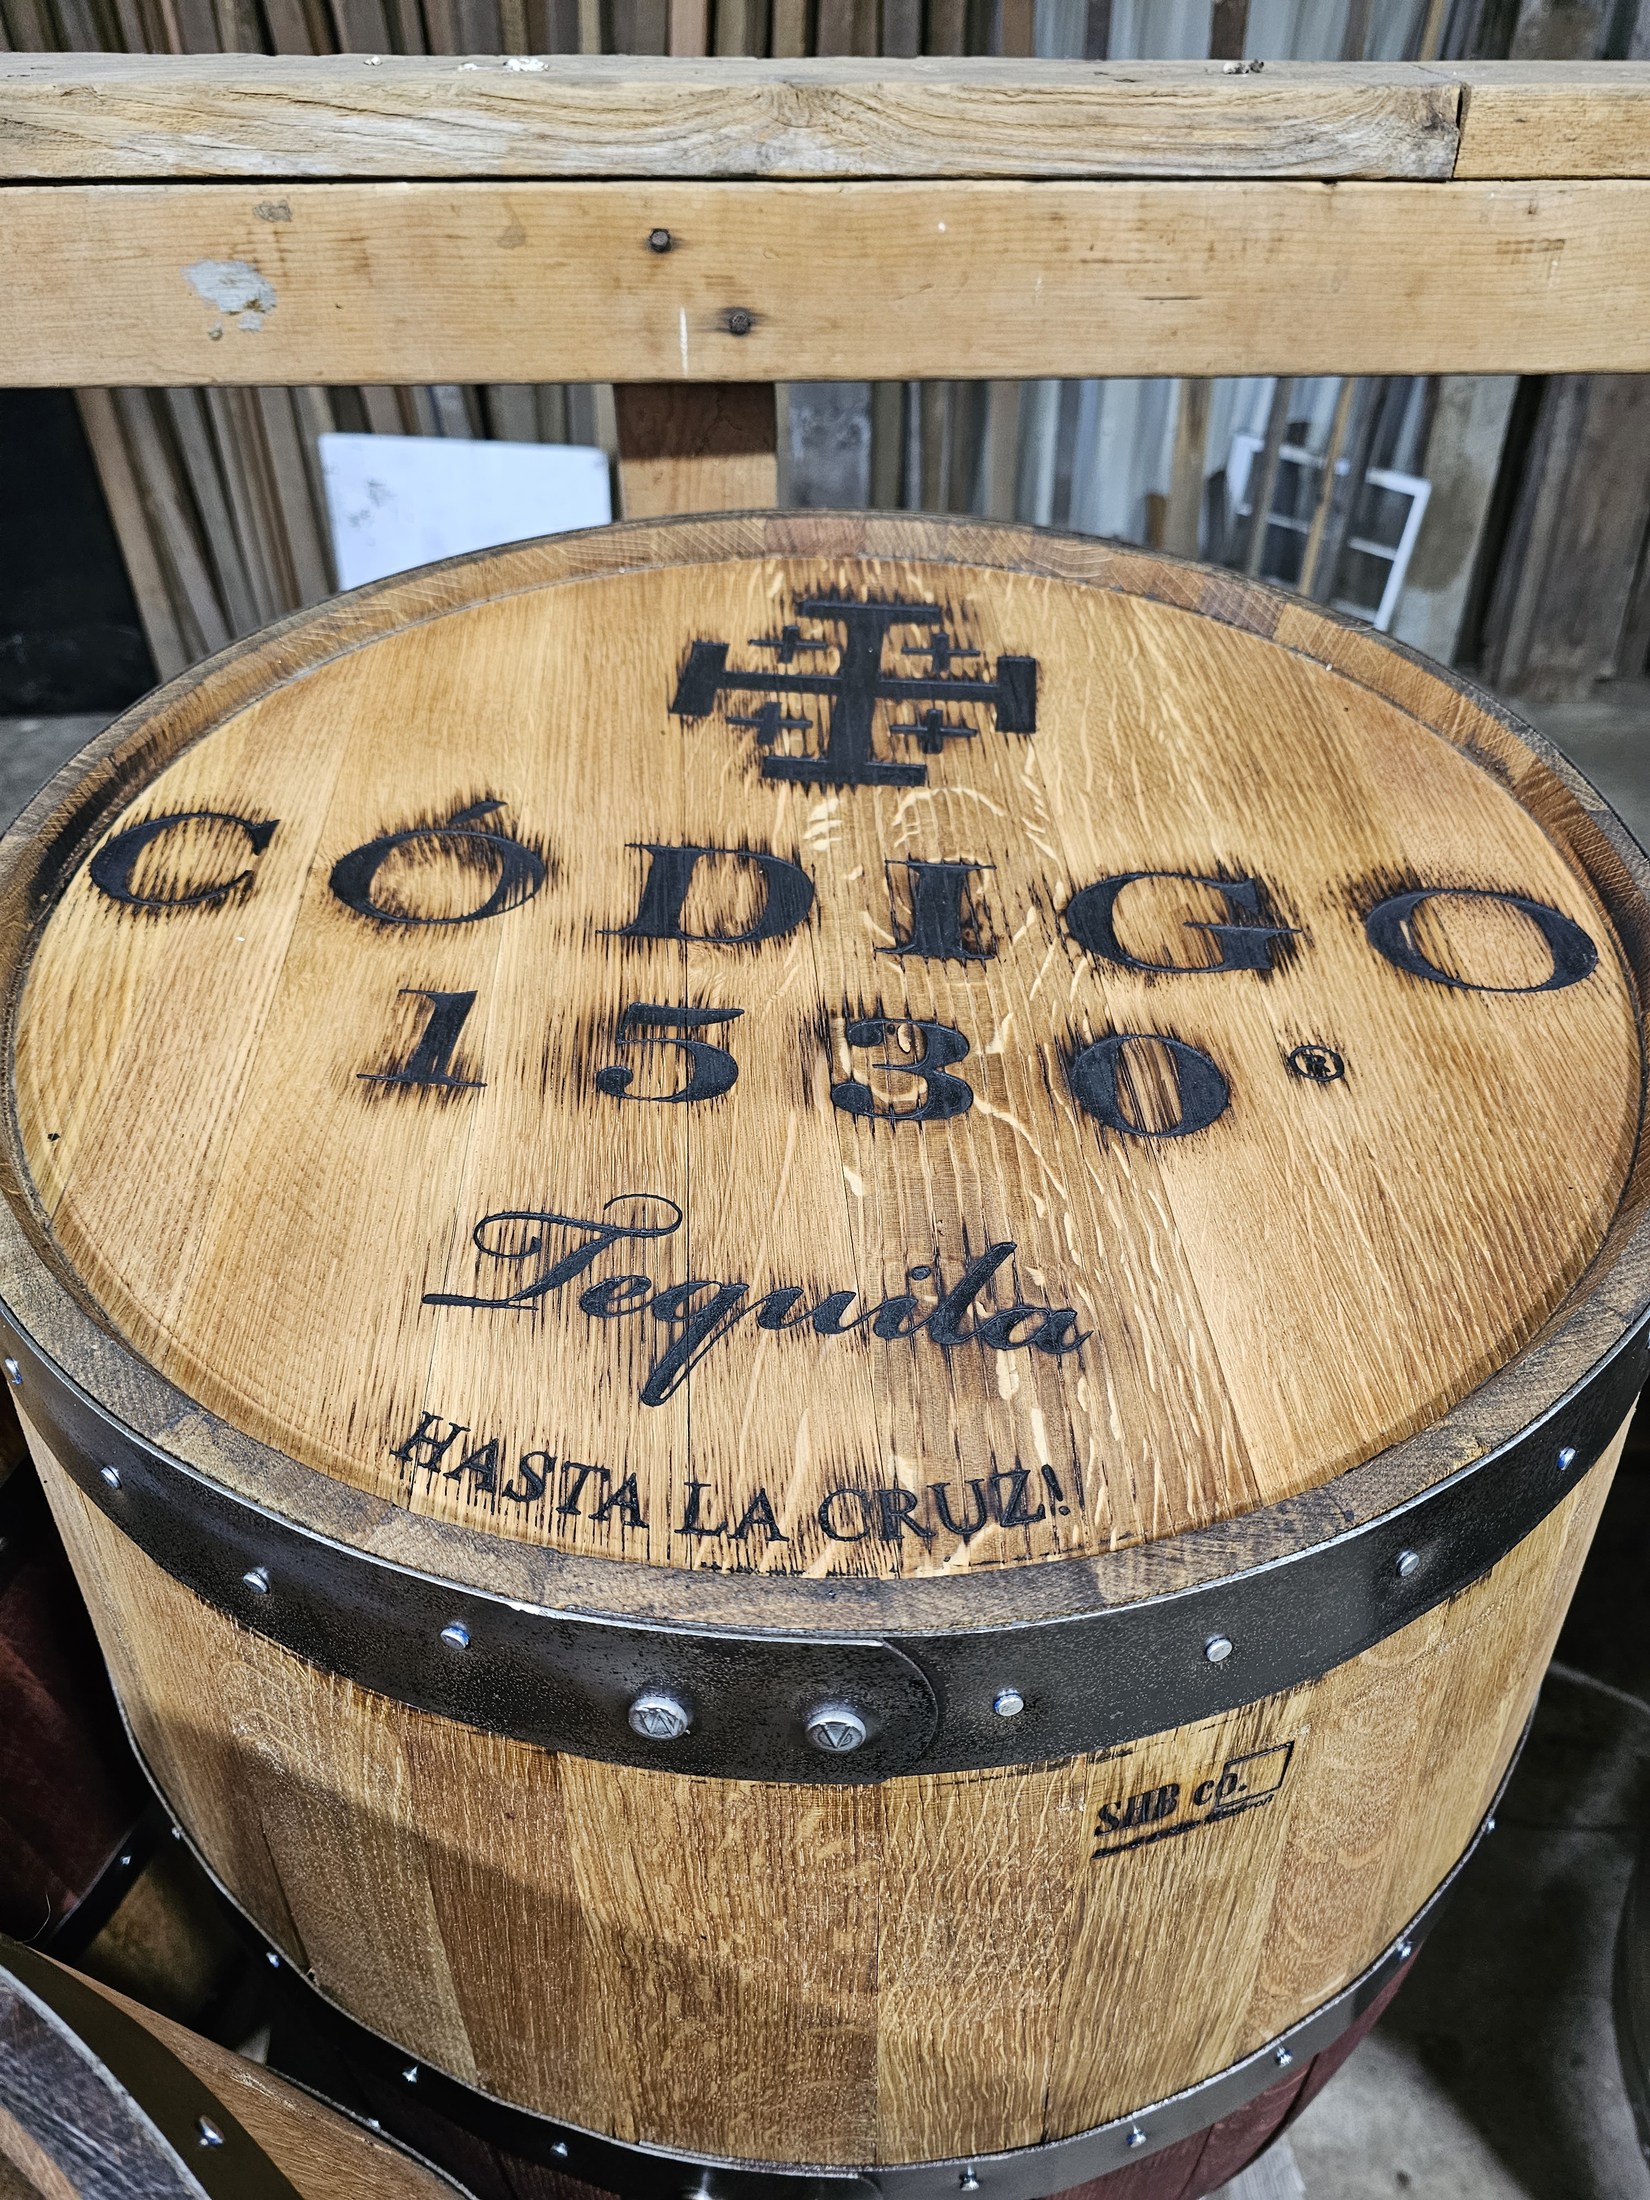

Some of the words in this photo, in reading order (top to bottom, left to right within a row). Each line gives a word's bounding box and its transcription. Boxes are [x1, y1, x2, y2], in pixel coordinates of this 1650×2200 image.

[90, 800, 1599, 993] CÓDIGO
[421, 1193, 1094, 1407] Tequila
[389, 1410, 649, 1529] HASTA
[675, 1481, 789, 1543] LA
[817, 1463, 1074, 1543] CRUZ!
[1094, 1782, 1180, 1837] SHB
